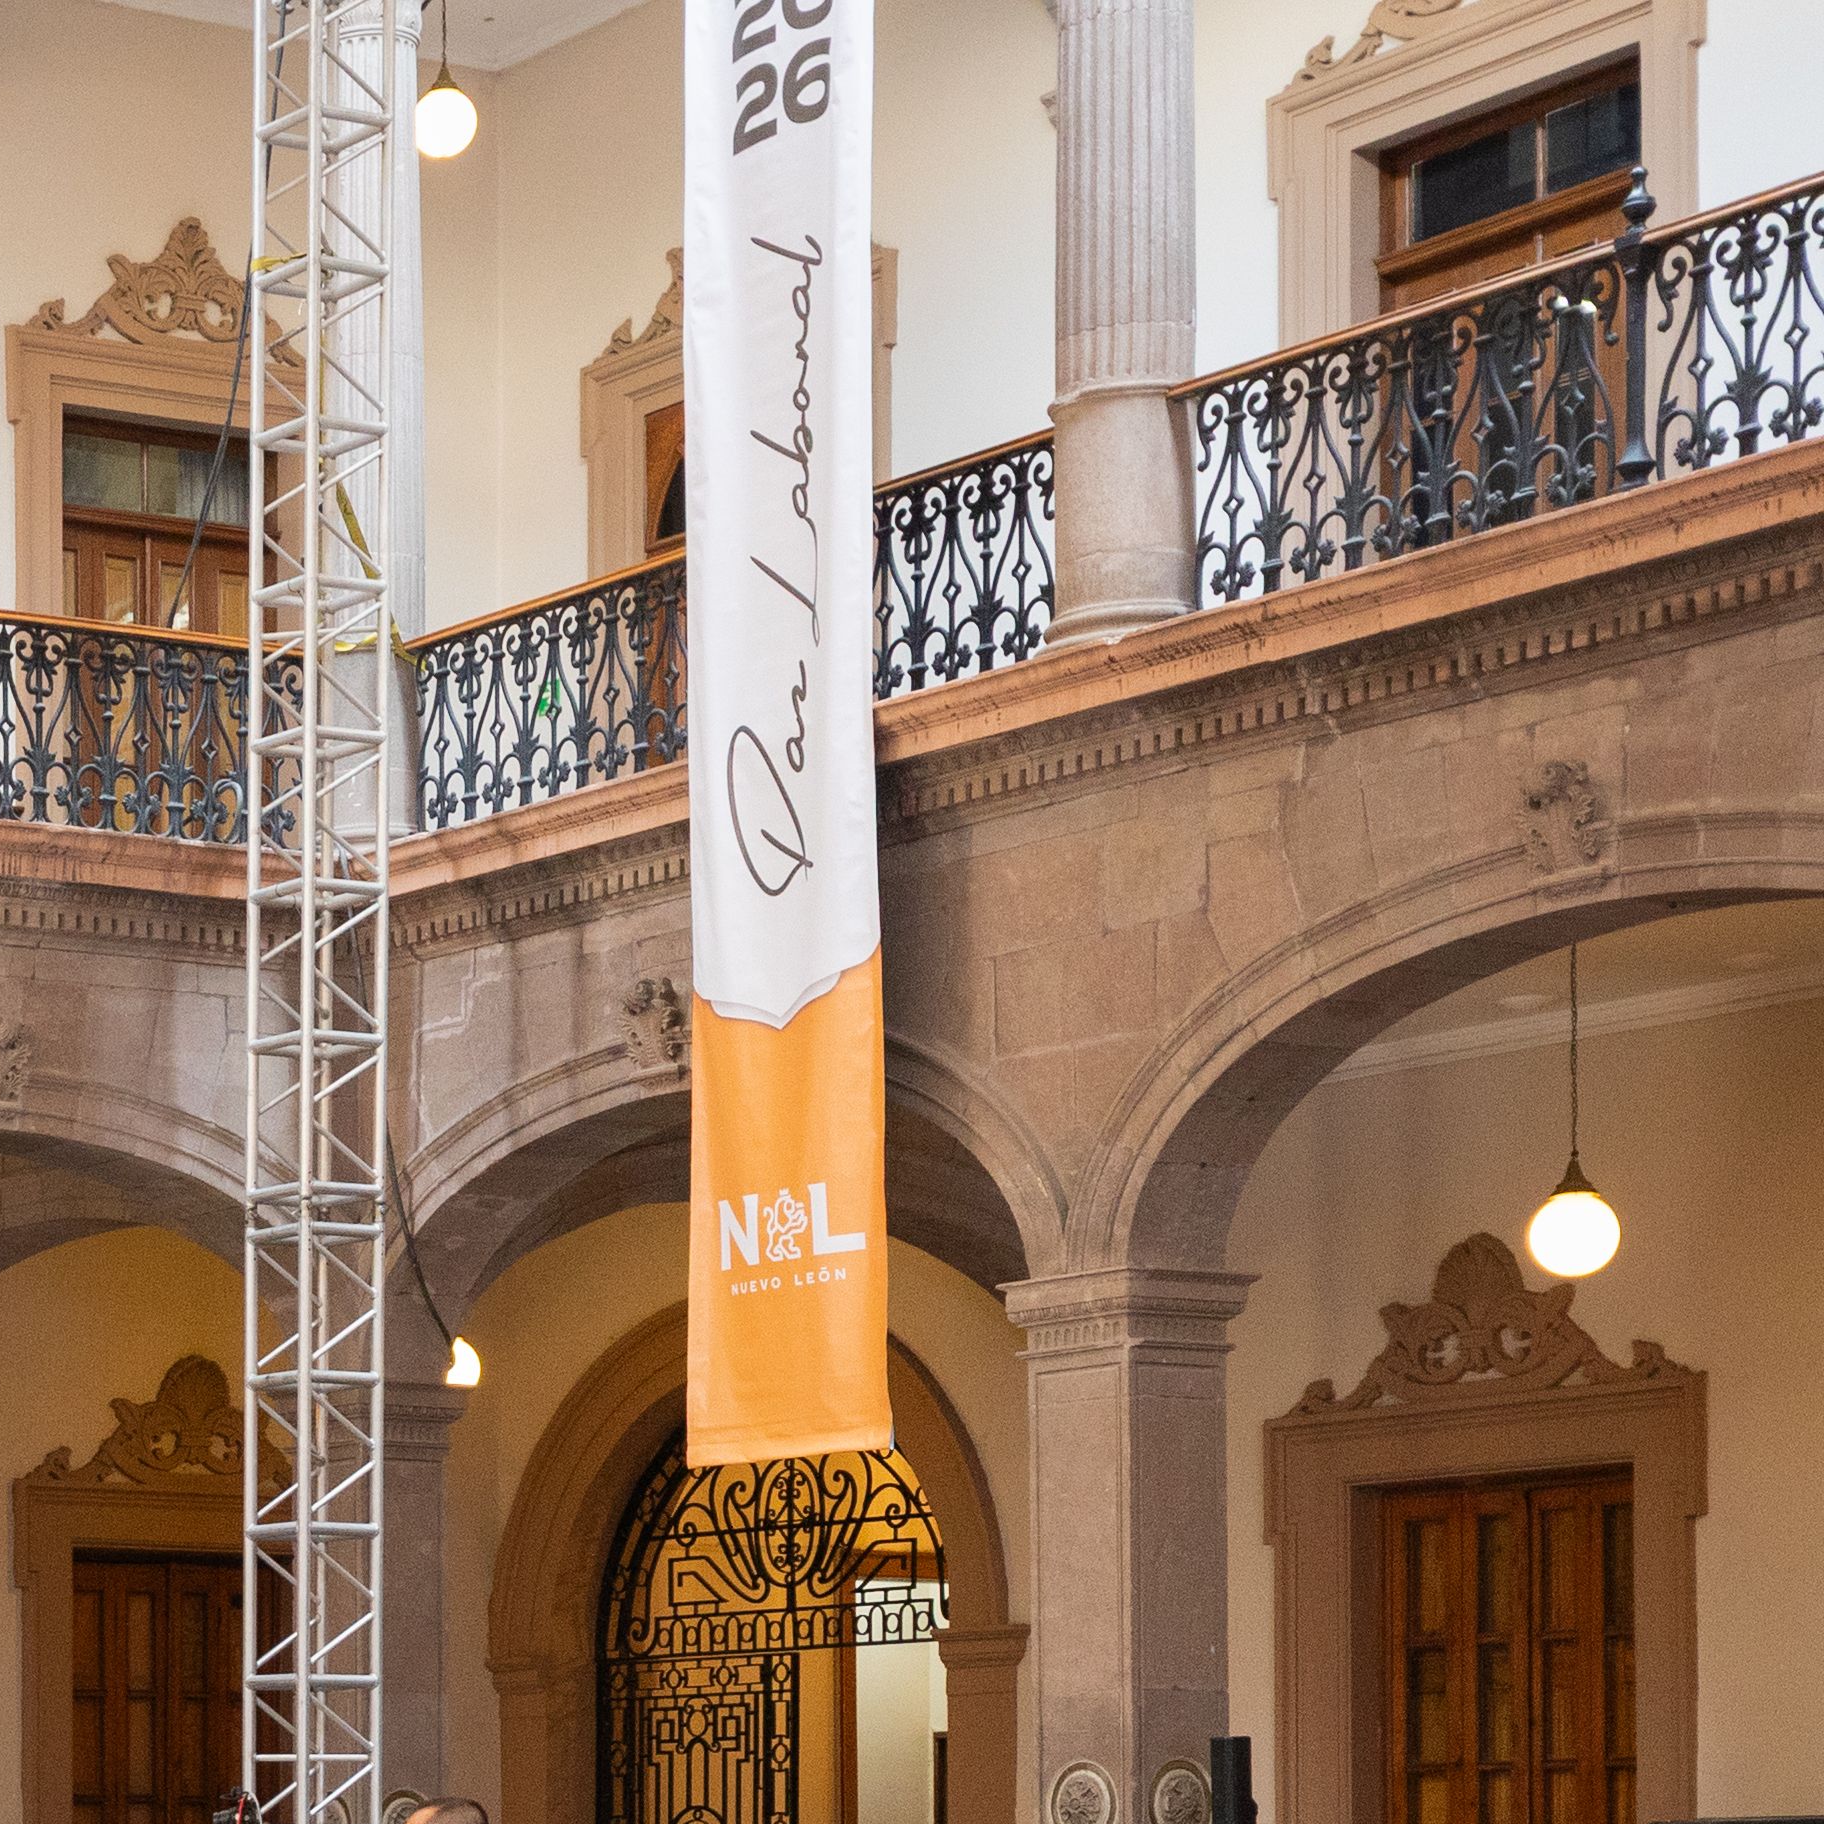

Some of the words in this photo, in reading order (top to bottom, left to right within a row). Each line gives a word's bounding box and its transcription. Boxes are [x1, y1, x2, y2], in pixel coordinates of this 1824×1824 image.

[732, 37, 832, 156] 26
[750, 233, 824, 648] Laboral
[731, 1277, 782, 1296] NUEVO
